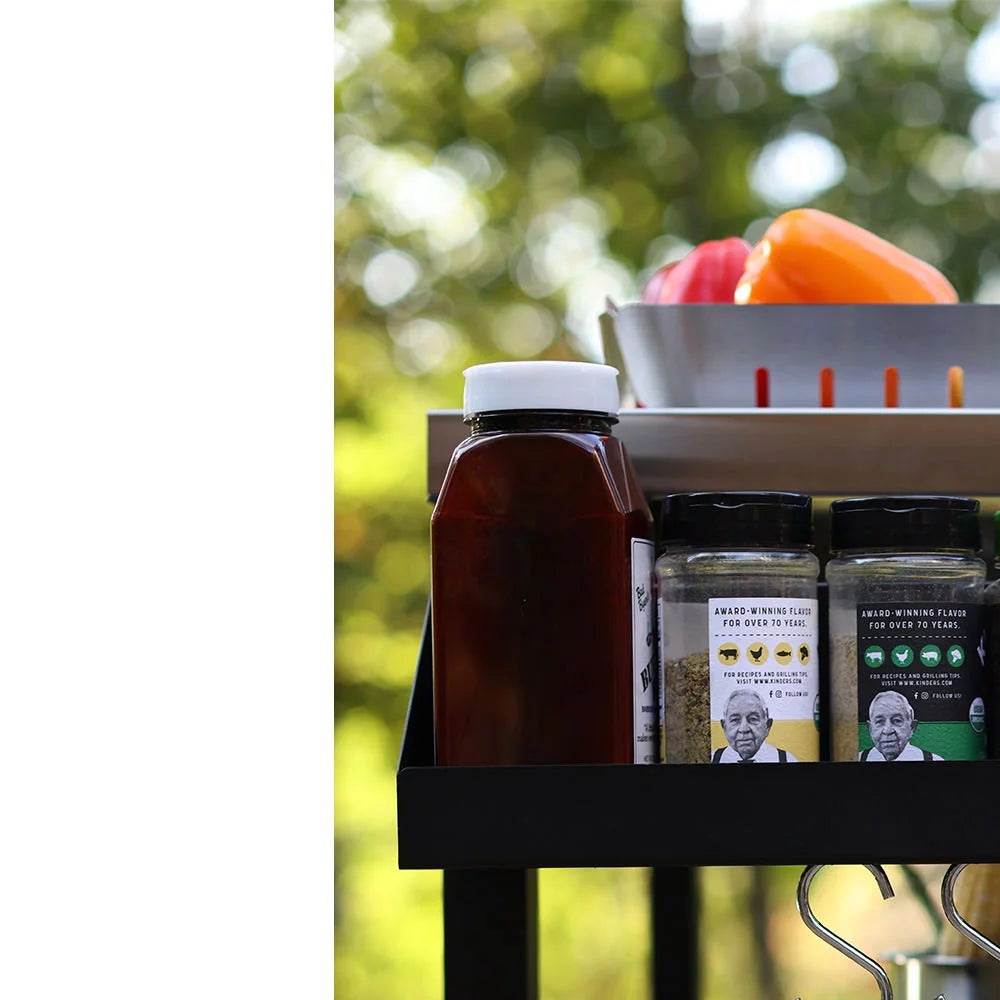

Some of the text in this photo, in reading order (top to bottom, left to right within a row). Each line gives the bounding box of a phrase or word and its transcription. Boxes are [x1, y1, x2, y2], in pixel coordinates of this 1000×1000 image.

[789, 607, 812, 616] FLAVOR
[937, 608, 967, 617] FLAVOR
[723, 619, 808, 628] FOR OVER 70 YEARS.
[869, 621, 961, 630] FOR OVER 70 YEARS.
